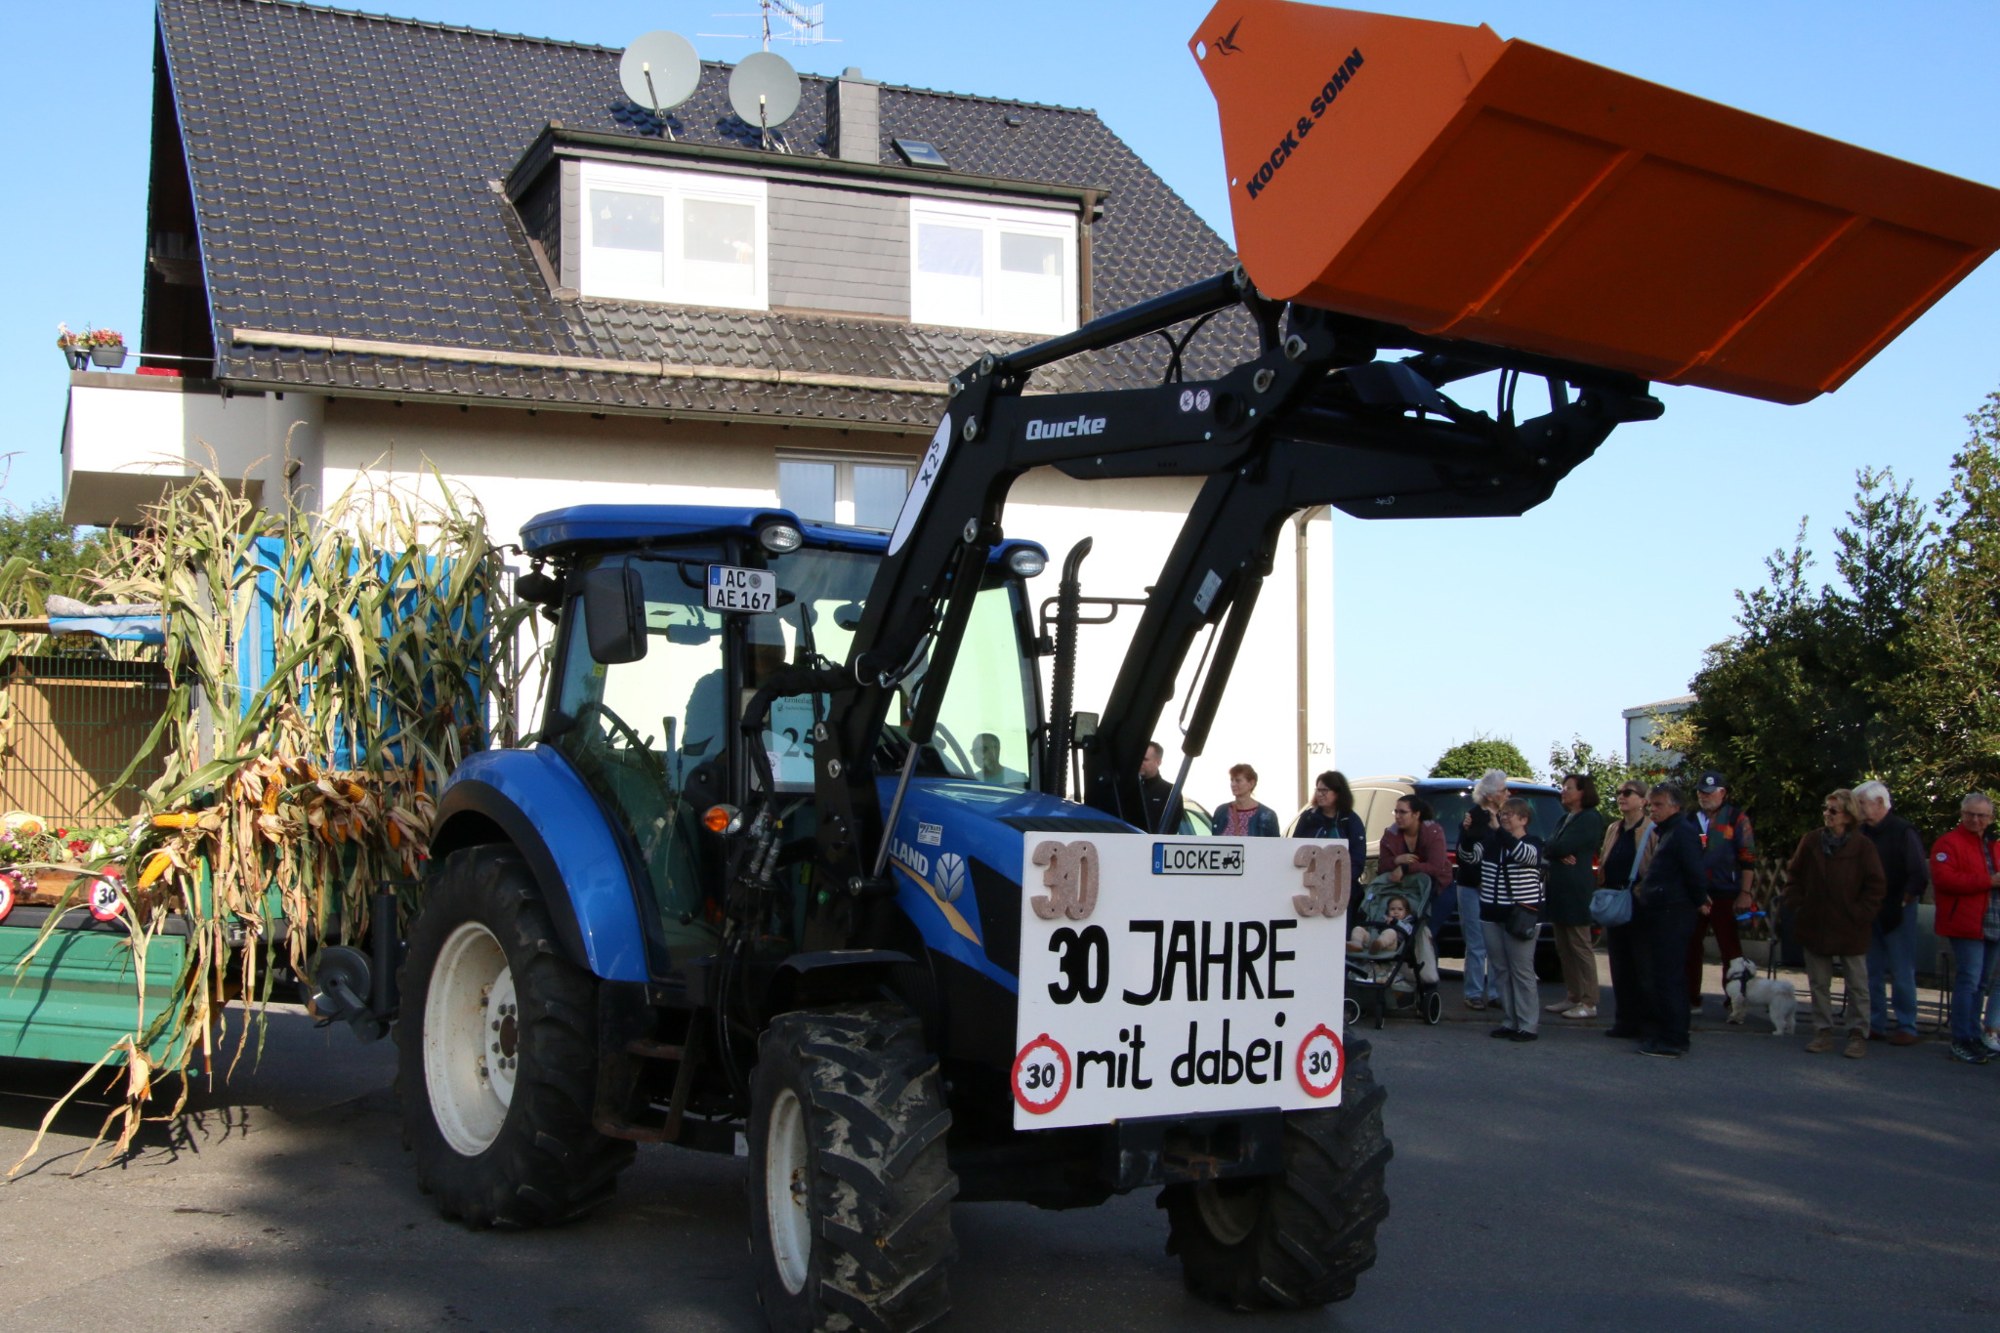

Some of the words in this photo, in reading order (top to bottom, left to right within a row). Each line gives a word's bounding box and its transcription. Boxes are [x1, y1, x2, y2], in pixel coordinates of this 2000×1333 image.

[1245, 129, 1300, 200] KOCK
[1296, 116, 1315, 139] &
[1310, 47, 1365, 119] SOHN
[1025, 414, 1107, 440] Quicke
[726, 570, 746, 588] AC
[716, 589, 737, 607] AE
[741, 591, 771, 610] 167
[1164, 850, 1221, 870] LOCKE
[1030, 840, 1100, 920] 30
[1292, 844, 1351, 918] 30
[98, 888, 117, 904] 30
[1047, 925, 1110, 1005] 30
[1123, 919, 1297, 1006] JAHRE
[1076, 1024, 1152, 1090] mit
[1170, 1011, 1286, 1087] dabei
[1308, 1051, 1332, 1076] 30
[1025, 1063, 1056, 1089] 30
